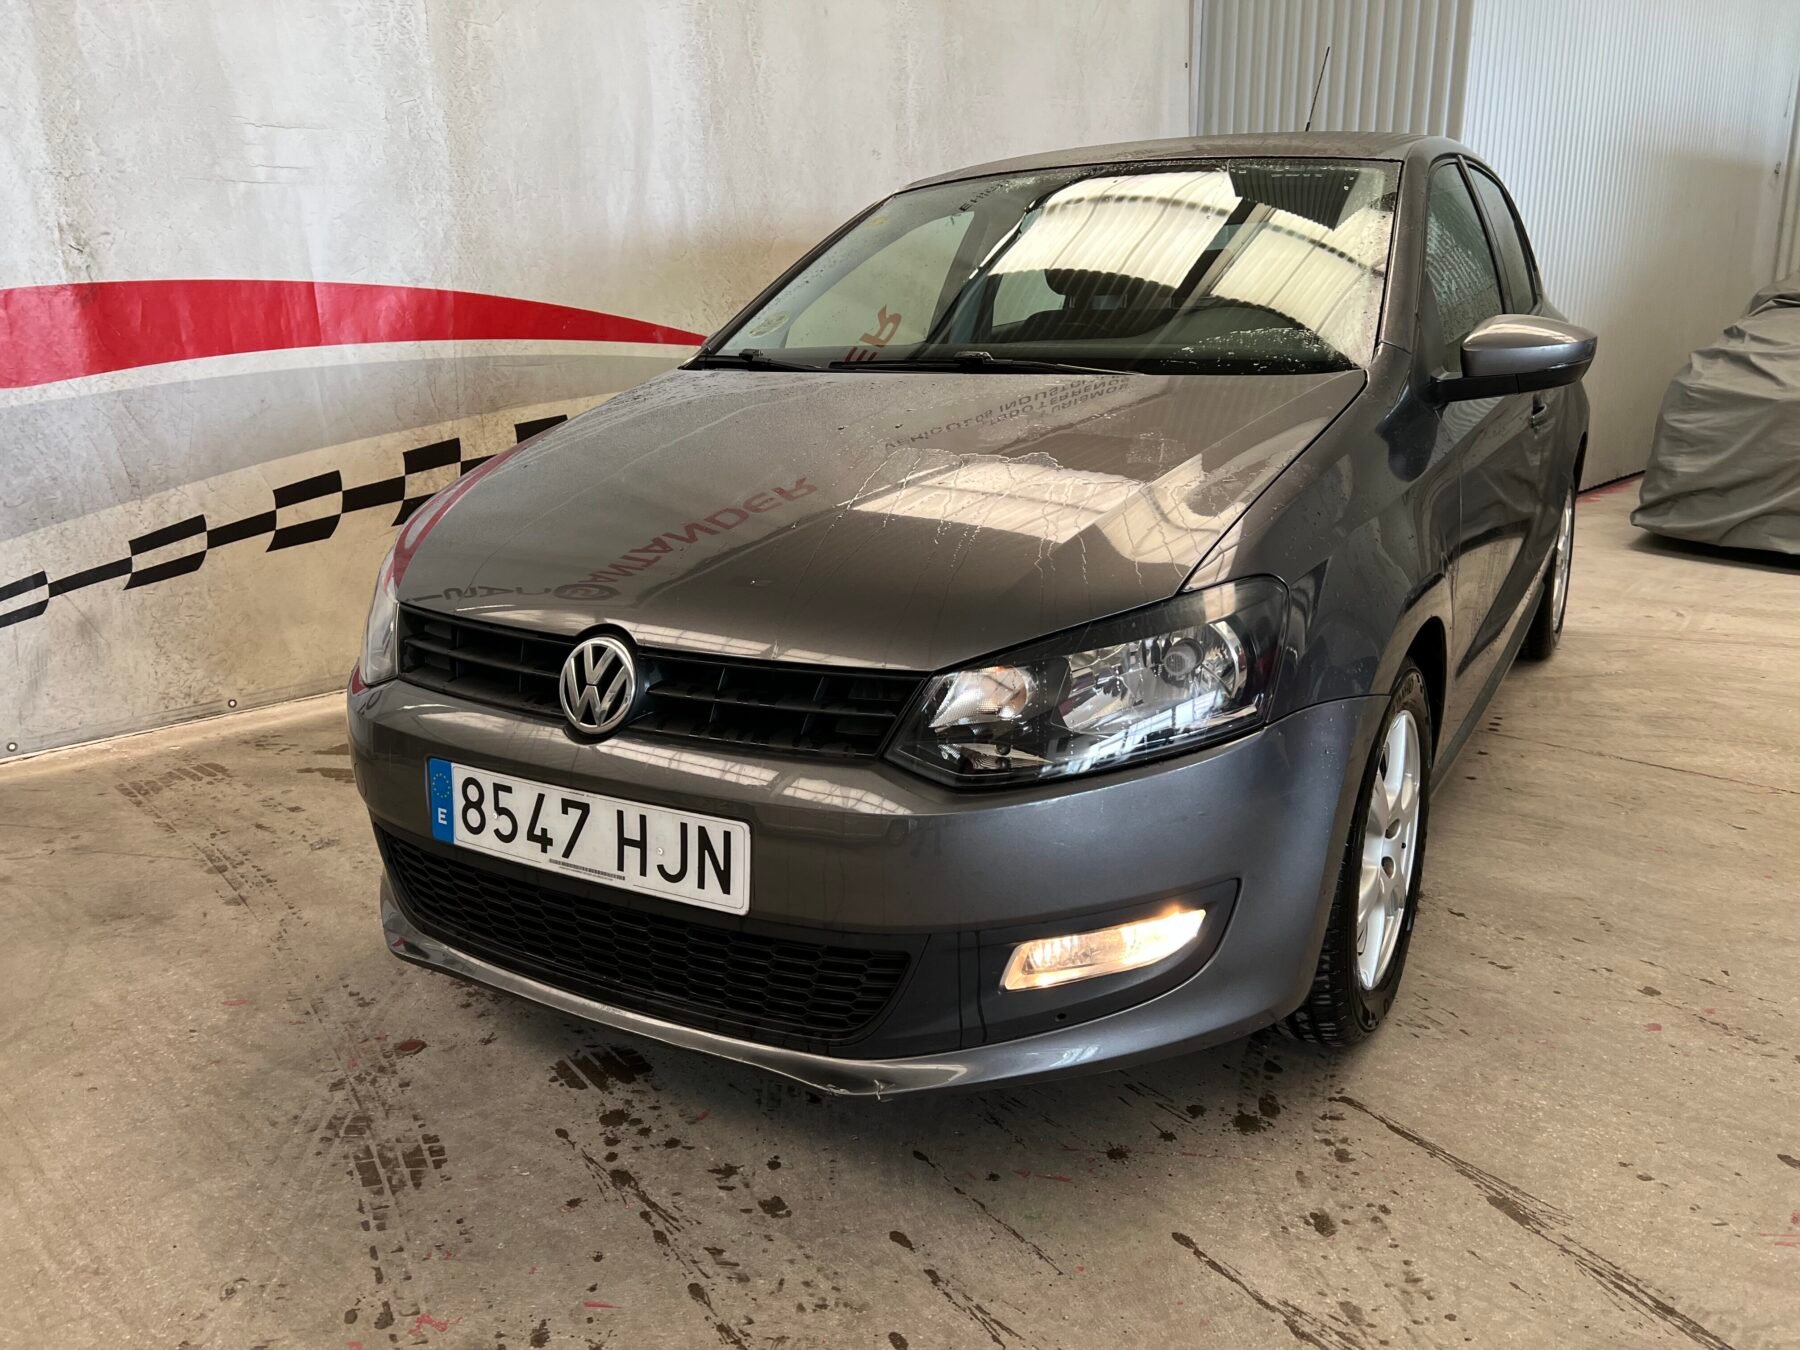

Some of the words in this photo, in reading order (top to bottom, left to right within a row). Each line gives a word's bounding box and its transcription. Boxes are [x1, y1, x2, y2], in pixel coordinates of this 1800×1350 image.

[437, 807, 448, 825] E
[461, 776, 591, 860] 8547
[616, 809, 732, 896] HJN
